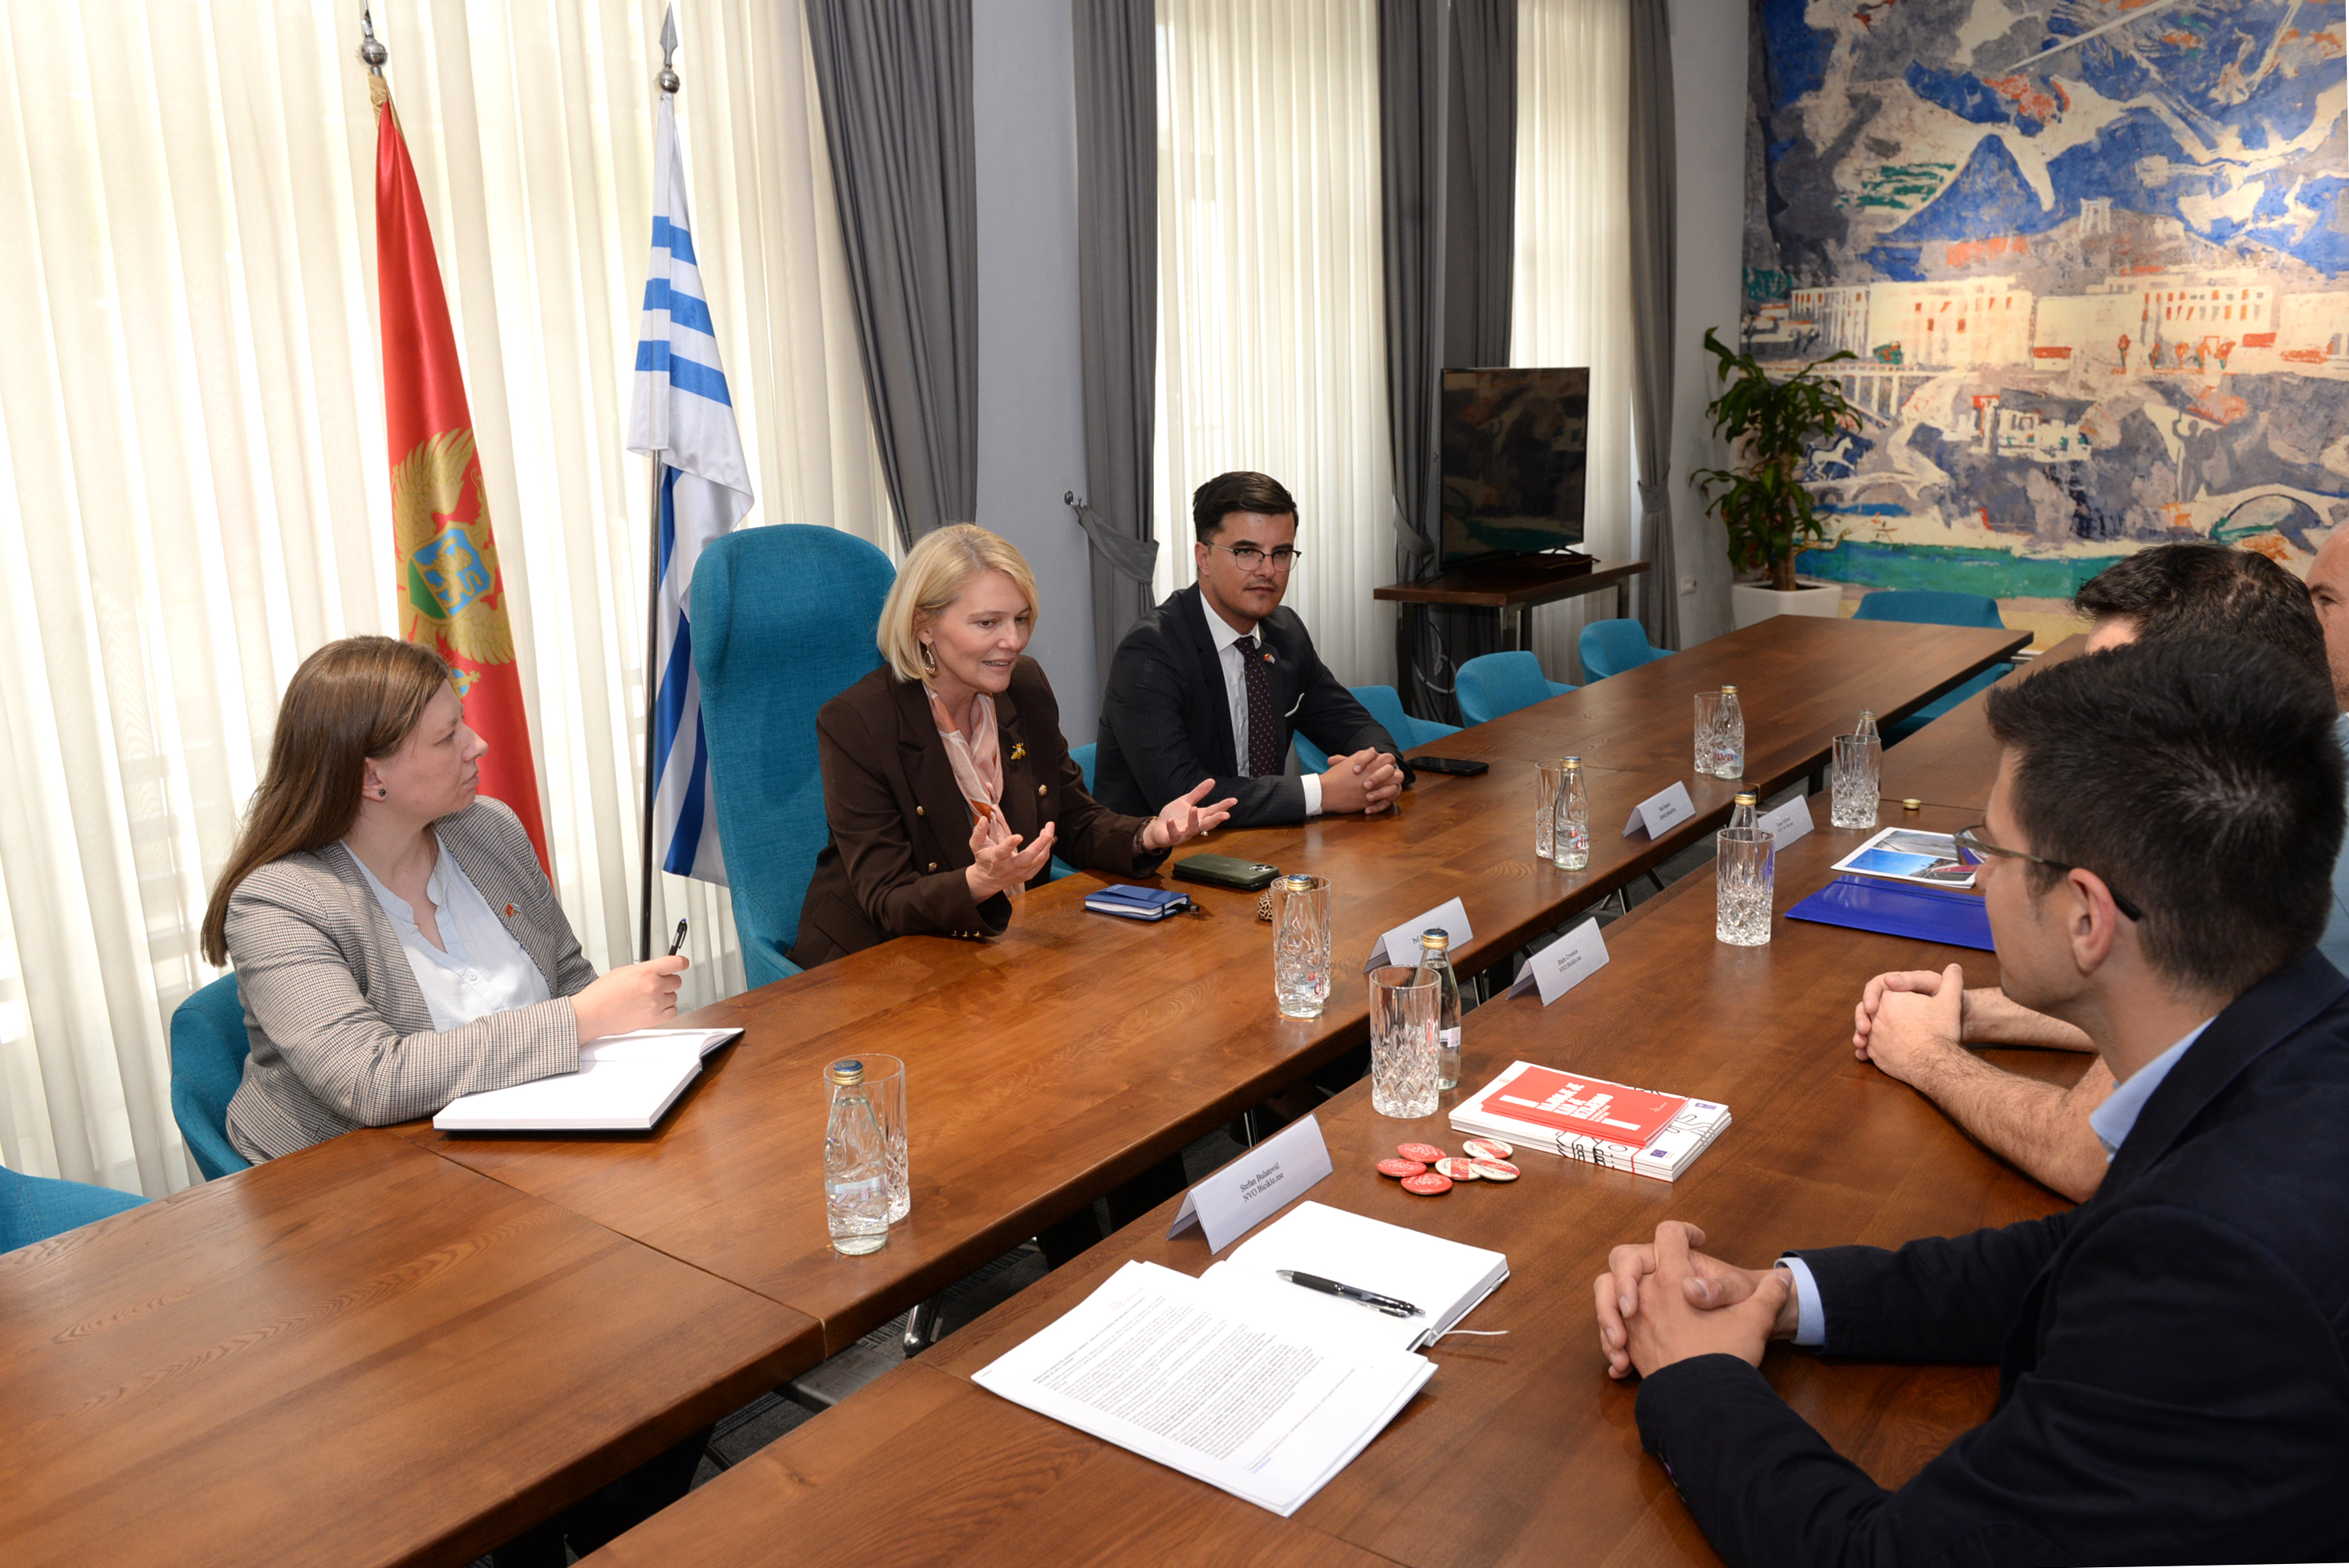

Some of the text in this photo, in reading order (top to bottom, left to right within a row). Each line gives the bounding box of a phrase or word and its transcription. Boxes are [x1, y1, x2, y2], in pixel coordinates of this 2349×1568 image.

[1240, 1161, 1280, 1192] Stefan Bulatović
[1242, 1172, 1284, 1203] NVO Biciklo.me
